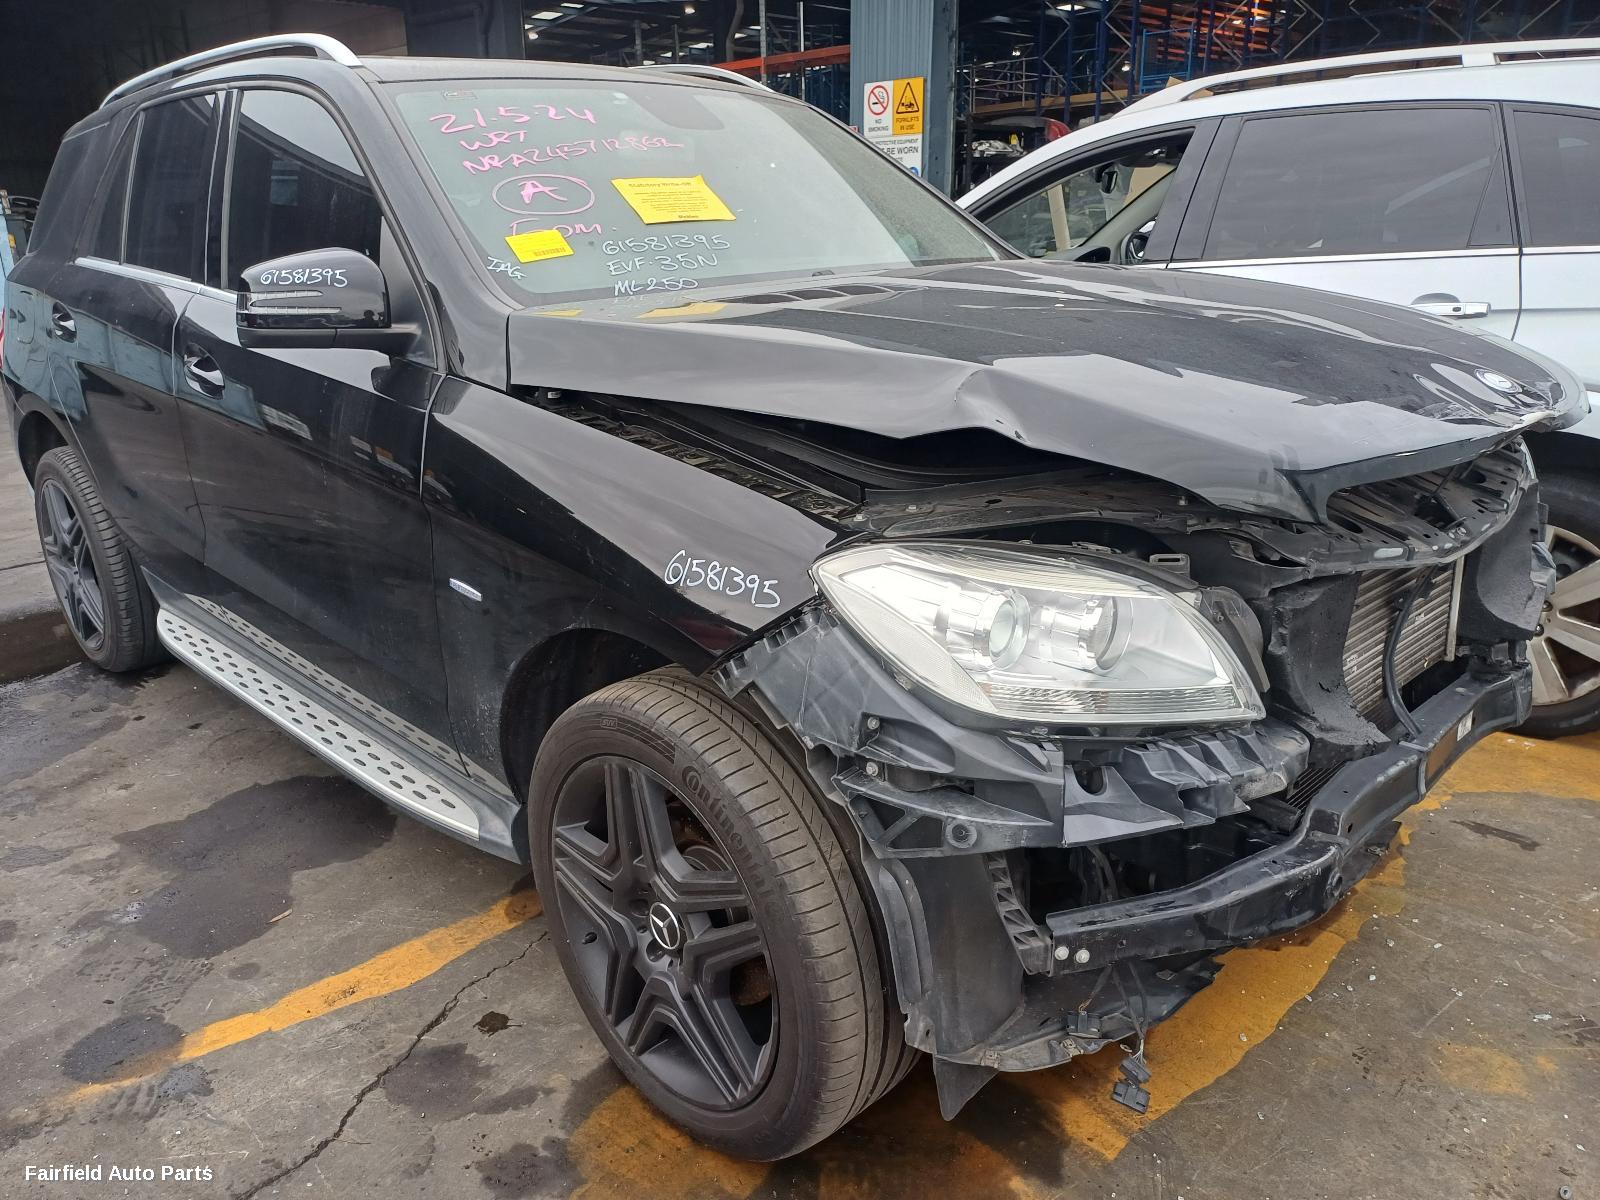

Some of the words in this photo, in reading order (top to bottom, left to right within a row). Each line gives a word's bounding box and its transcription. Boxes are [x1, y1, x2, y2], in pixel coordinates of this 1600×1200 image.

[897, 146, 919, 154] WORN
[602, 234, 731, 255] 61581395
[260, 268, 348, 288] 61581395
[664, 549, 781, 609] 61581395
